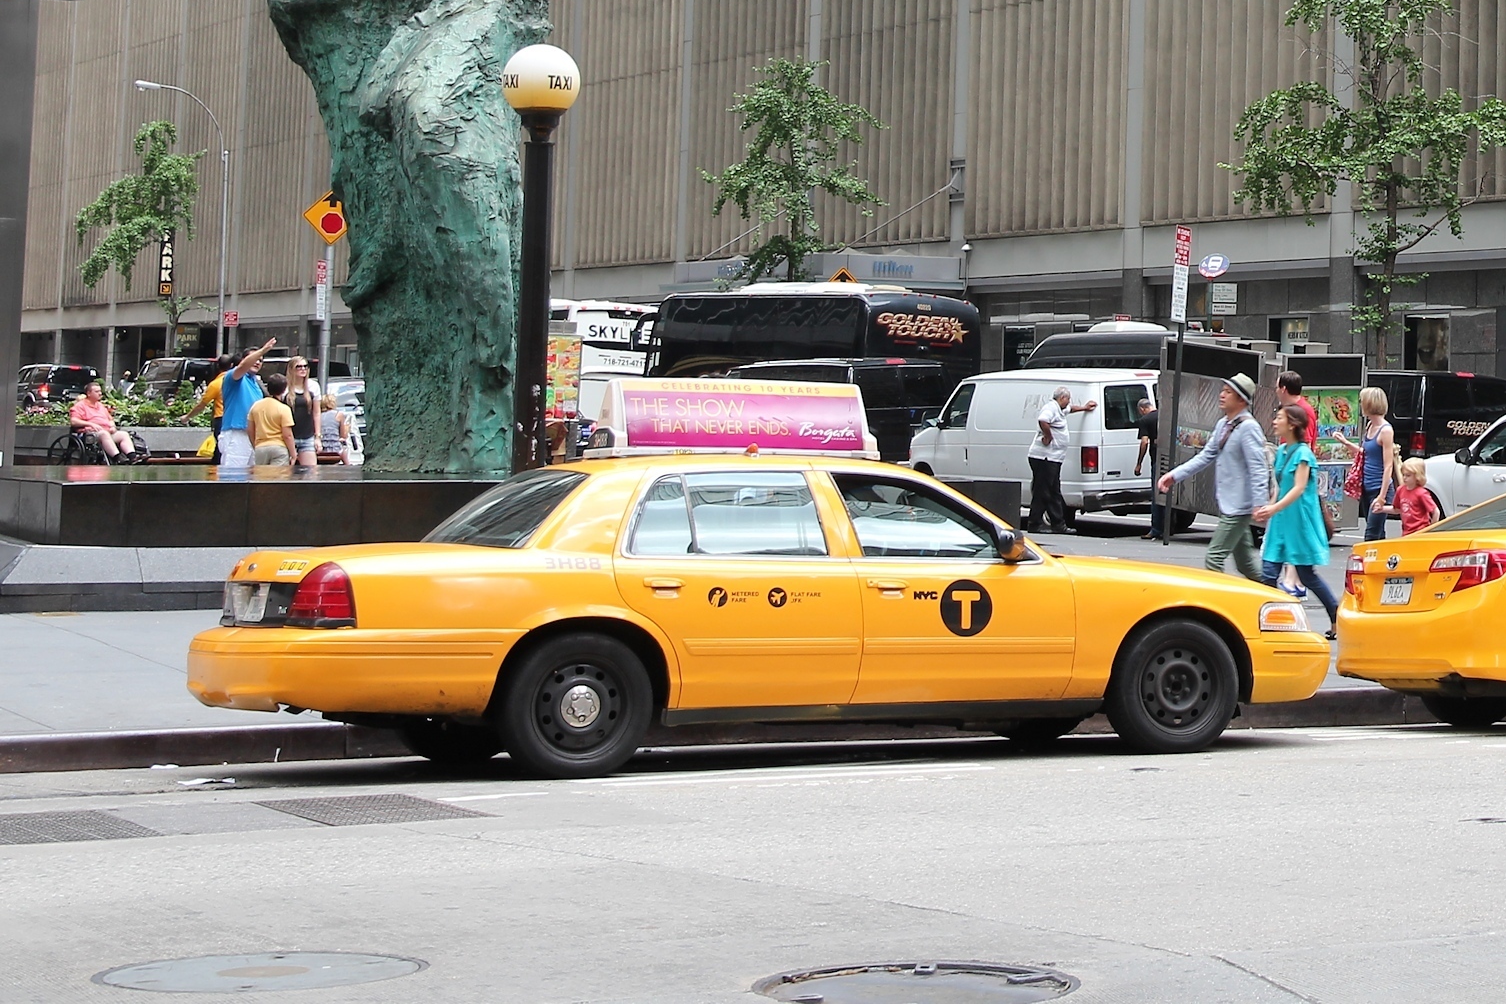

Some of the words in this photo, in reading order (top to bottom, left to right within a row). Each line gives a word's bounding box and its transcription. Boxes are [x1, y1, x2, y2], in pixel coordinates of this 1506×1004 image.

[548, 75, 572, 90] TAXI
[878, 313, 957, 329] GOLDEN
[888, 323, 952, 340] TOUCH
[661, 382, 752, 392] CELEBRATING
[760, 385, 773, 393] 10
[781, 386, 821, 394] YEARS
[630, 397, 668, 417] THE
[675, 398, 745, 418] SHOW
[650, 418, 693, 434] THAT
[695, 418, 743, 436] NEVER
[749, 420, 792, 437] ENDS.
[799, 421, 856, 444] Borgata
[1447, 420, 1490, 430] GOLDEN
[545, 557, 601, 570] 3H88
[914, 591, 938, 600] NYC
[952, 591, 981, 629] T
